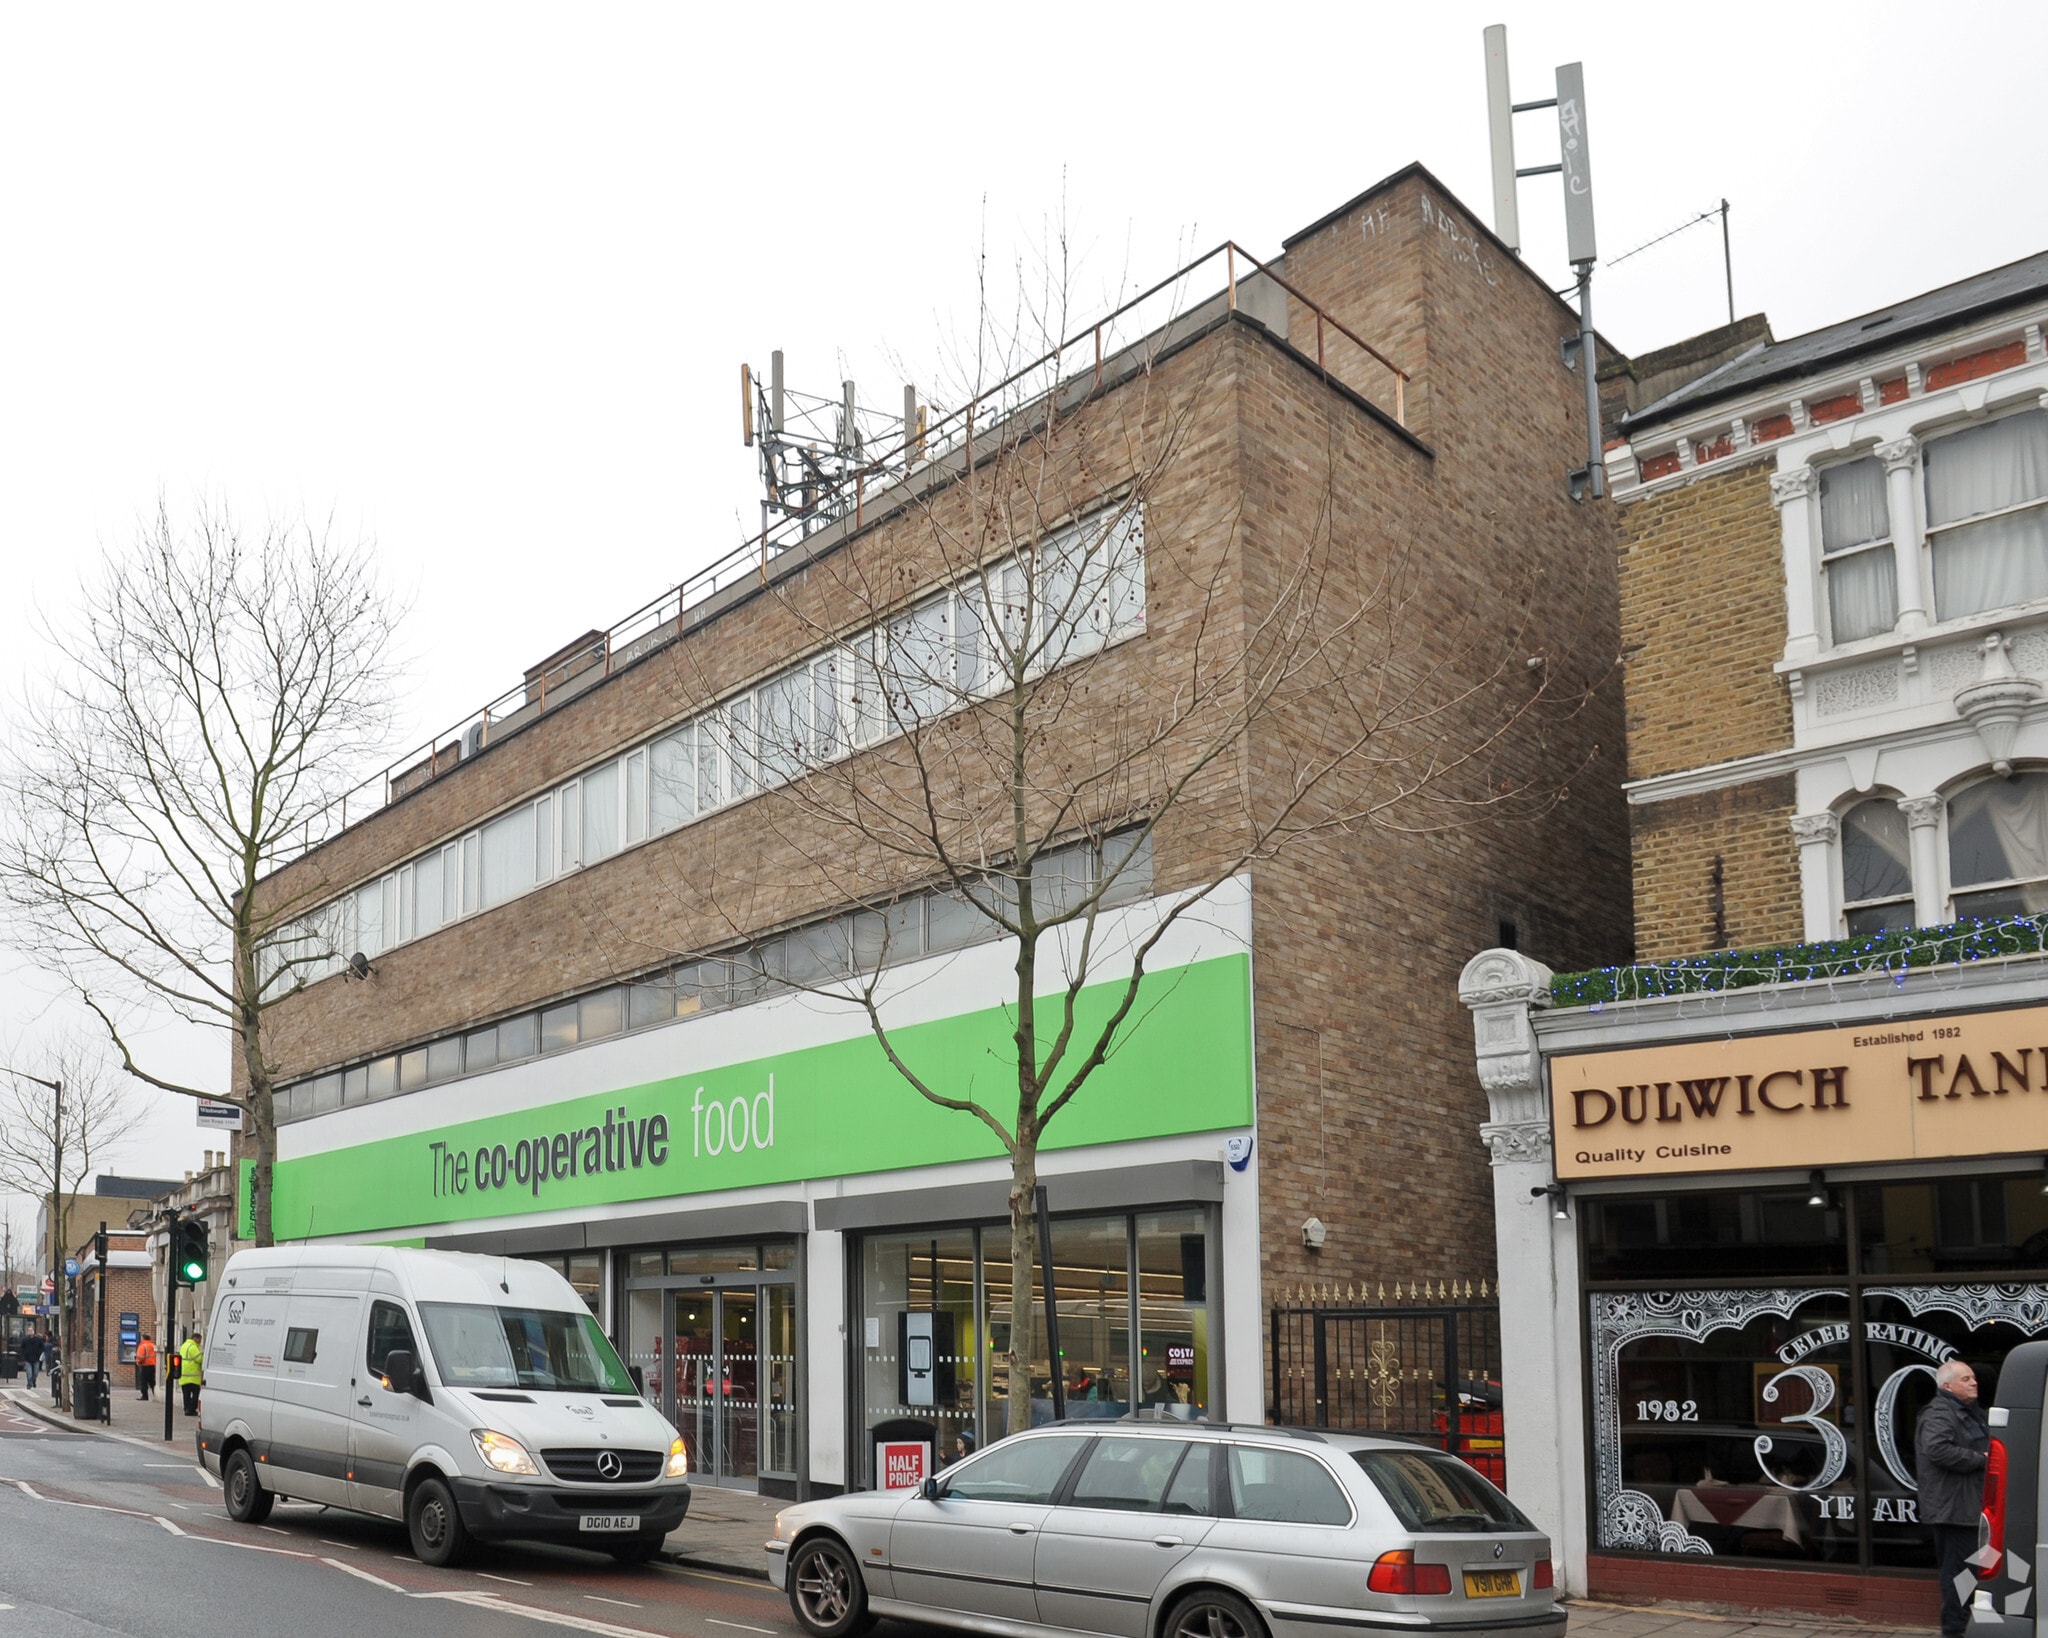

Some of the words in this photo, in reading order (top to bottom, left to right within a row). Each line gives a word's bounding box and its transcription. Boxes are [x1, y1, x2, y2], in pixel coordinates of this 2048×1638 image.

[1853, 1030, 1924, 1048] Established
[1932, 1026, 1962, 1040] 1982
[1570, 1065, 1851, 1130] DULWICH
[429, 1141, 469, 1198] The
[474, 1105, 670, 1197] co-operative
[690, 1072, 775, 1159] food
[1575, 1148, 1646, 1165] Quality
[1655, 1143, 1732, 1159] Cuisine
[1636, 1399, 1699, 1422] 1982
[888, 1454, 920, 1472] HALF
[888, 1471, 920, 1487] PRICE
[1809, 1494, 1921, 1524] YEAR
[586, 1516, 611, 1529] DG10
[613, 1516, 634, 1529] AEJ
